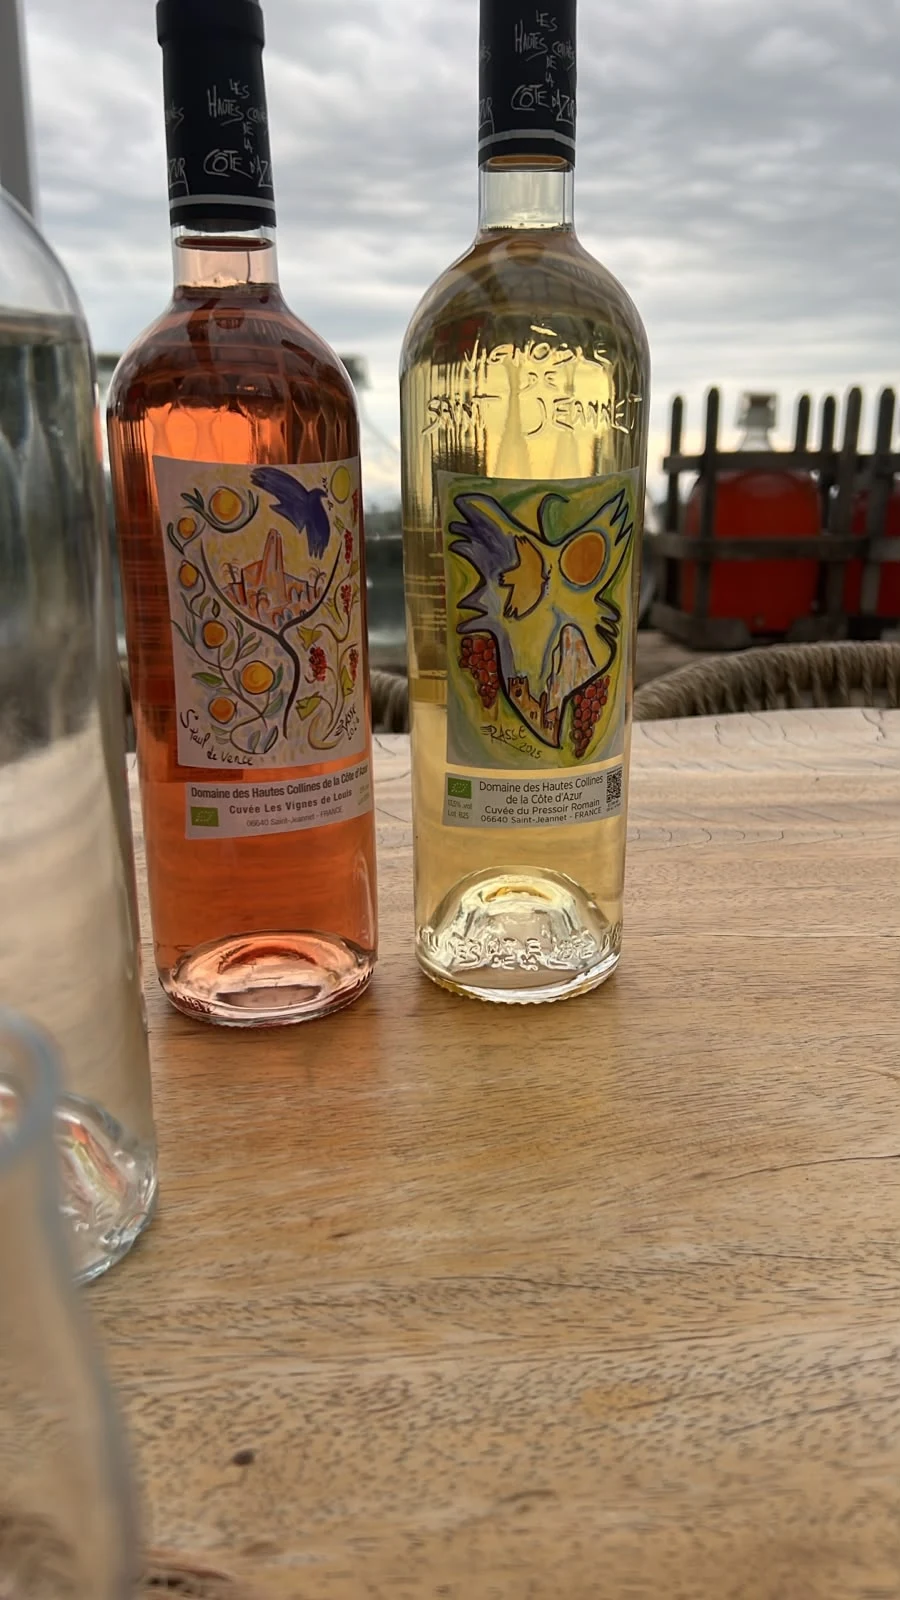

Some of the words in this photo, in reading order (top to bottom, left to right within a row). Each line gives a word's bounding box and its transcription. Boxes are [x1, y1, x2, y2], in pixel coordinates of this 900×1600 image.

[536, 10, 558, 31] LES
[515, 19, 548, 61] HAUTES
[207, 85, 244, 126] HAUTES
[207, 746, 217, 761] de
[221, 751, 254, 766] Vence
[191, 787, 230, 799] Domaine
[232, 787, 250, 799] des
[252, 786, 285, 798] Hautes
[286, 782, 321, 796] Collines
[322, 778, 332, 789] de
[333, 776, 340, 786] la
[341, 771, 354, 784] Côte
[479, 781, 521, 793] Domaine
[523, 781, 540, 793] des
[543, 779, 573, 792] Hautes
[575, 775, 604, 788] Collines
[229, 805, 260, 814] Cuvée
[264, 803, 282, 813] Les
[285, 799, 318, 812] Vignes
[320, 796, 331, 805] de
[333, 789, 352, 802] Louis
[484, 805, 514, 816] Cuvée
[517, 805, 529, 815] du
[532, 805, 569, 815] Pressoir
[571, 800, 600, 811] Romain
[505, 795, 518, 805] de
[520, 794, 529, 805] la
[531, 793, 553, 804] Côte
[555, 791, 583, 802] d'Azur
[480, 814, 508, 824] 06640
[511, 814, 567, 825] Saint-Jeannet
[574, 807, 602, 819] FRANCE
